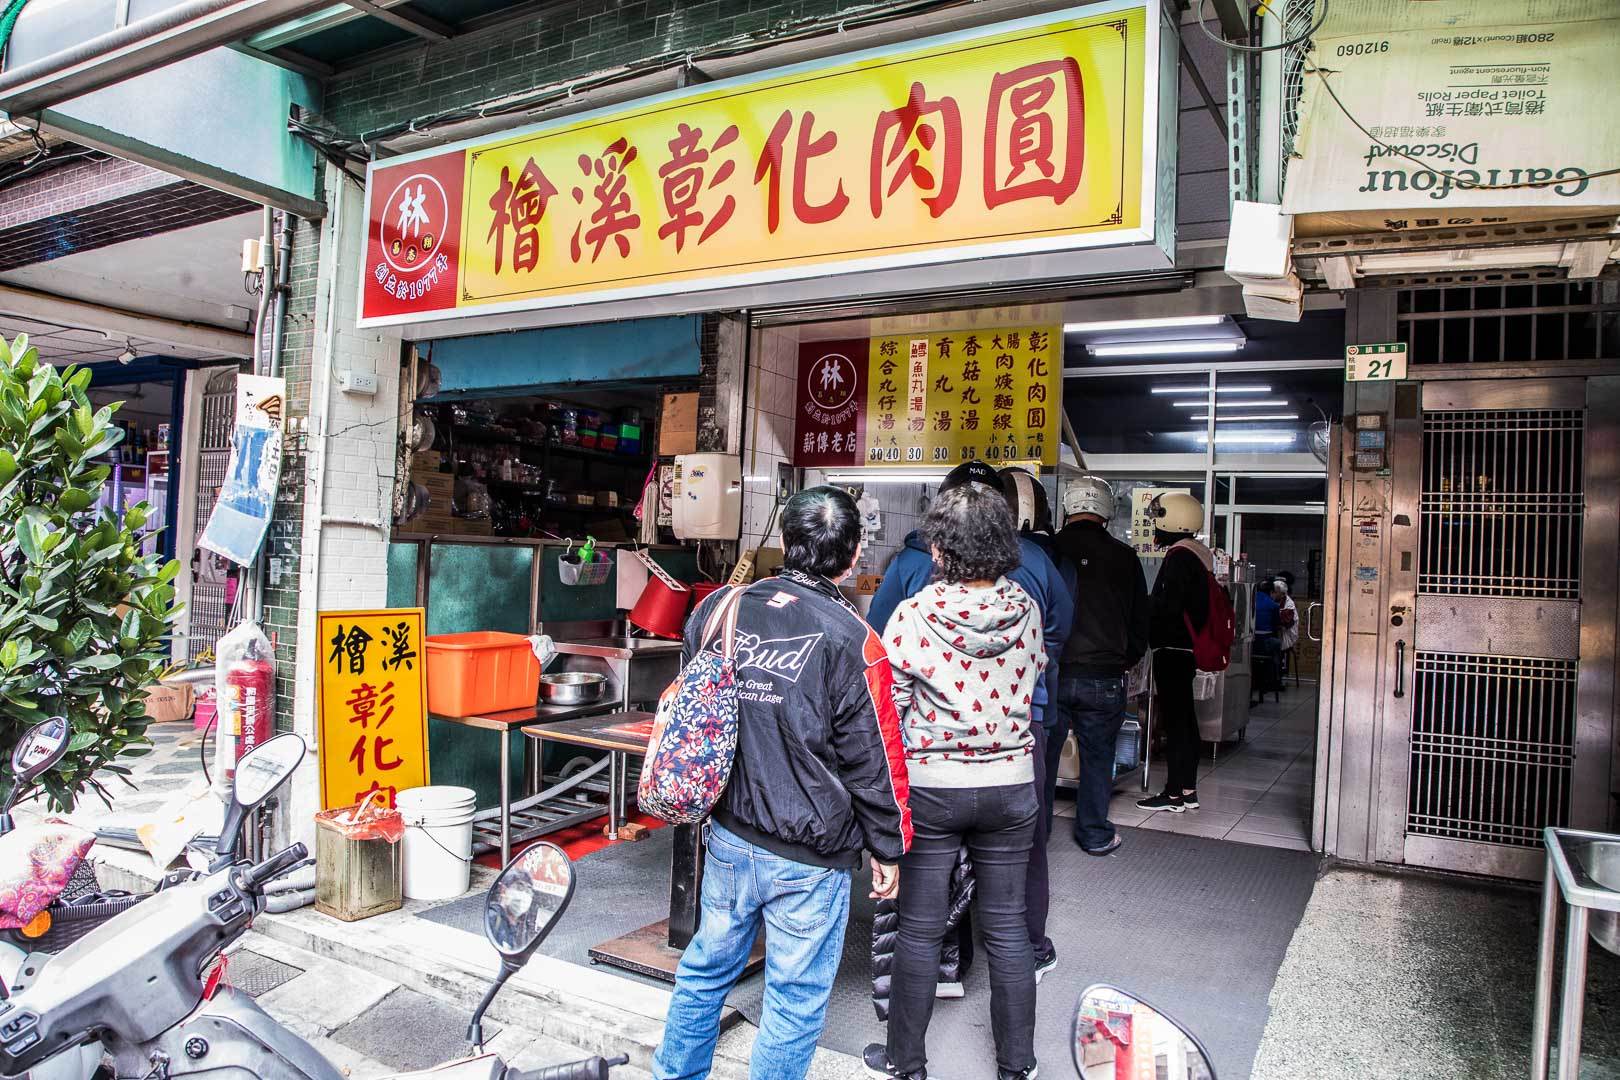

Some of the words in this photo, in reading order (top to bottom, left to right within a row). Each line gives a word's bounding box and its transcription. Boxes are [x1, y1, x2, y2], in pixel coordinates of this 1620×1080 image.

[1336, 41, 1389, 57] 912060
[1450, 67, 1474, 75] agent
[1476, 66, 1550, 74] Non-fluorescent
[1417, 91, 1452, 102] Rolls
[1455, 89, 1499, 101] Paper
[1503, 89, 1546, 100] Toilet
[1425, 100, 1546, 117] 捲筒式衛生紙
[1364, 142, 1478, 166] Discount
[487, 56, 1084, 276] 檜溪彰化肉圓
[1358, 167, 1590, 200] Carrefour
[396, 183, 431, 240] 林
[820, 359, 844, 391] 林
[1367, 359, 1392, 378] 21
[878, 340, 899, 430] 綜合丸仔湯
[933, 336, 954, 432] 貢丸湯
[960, 335, 982, 431] 香菇丸湯
[1027, 330, 1049, 429] 彰化肉圓
[803, 431, 857, 454] 薪傳老店
[870, 448, 883, 460] 30
[886, 447, 899, 460] 40
[908, 447, 921, 460] 30
[934, 447, 948, 460] 30
[962, 446, 975, 460] 35
[986, 446, 999, 459] 40
[1004, 446, 1017, 459] 50
[1027, 446, 1041, 458] 40
[792, 570, 820, 588] Bud
[328, 622, 417, 676] 檜溪
[713, 634, 813, 670] Bud
[746, 679, 773, 692] Great
[759, 691, 784, 704] Lager
